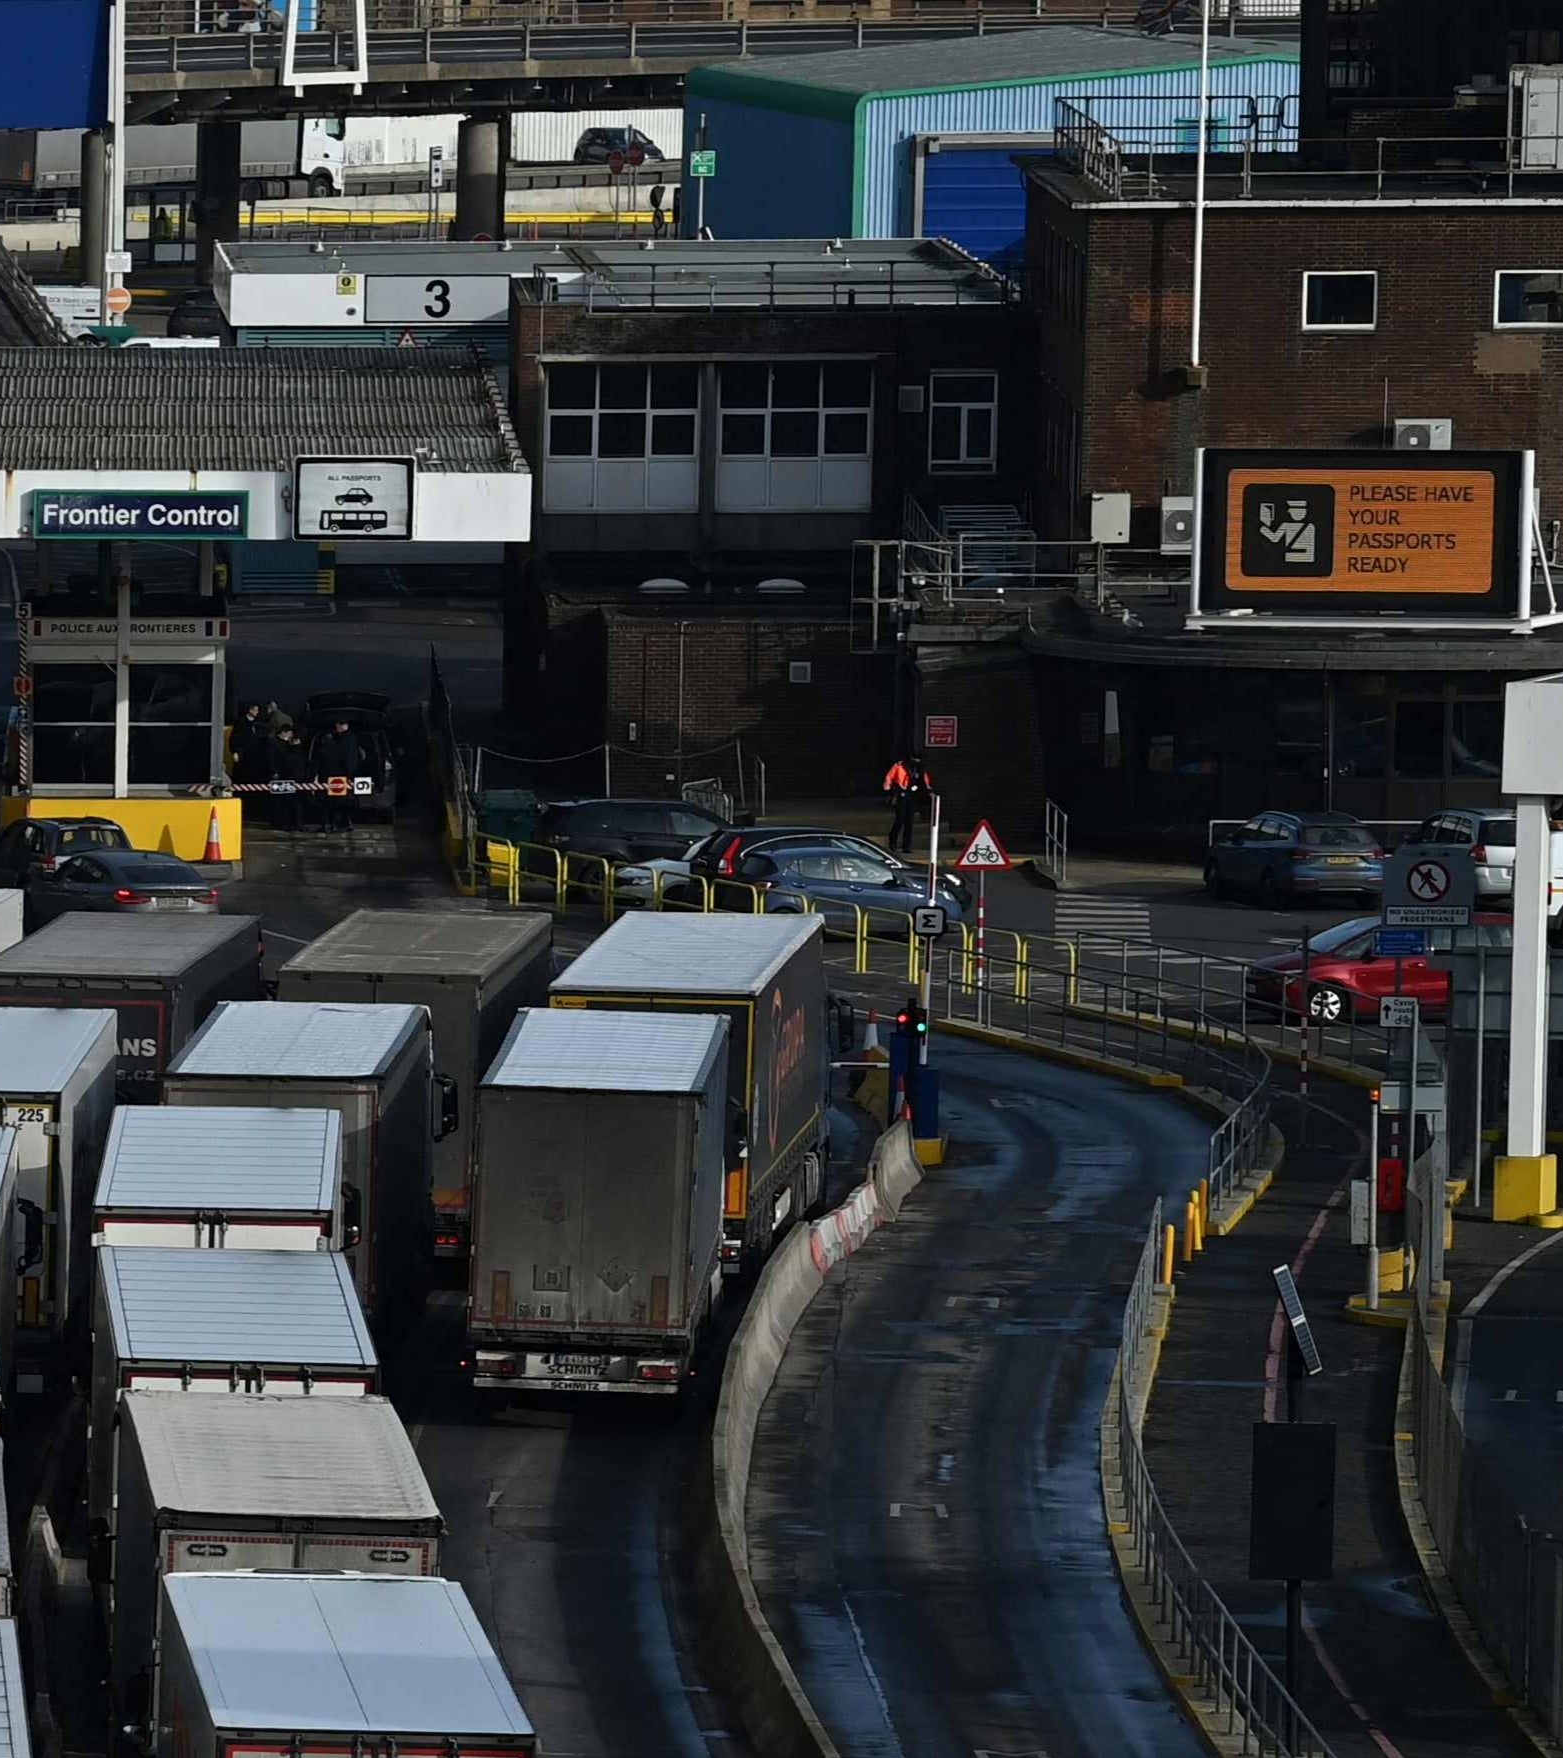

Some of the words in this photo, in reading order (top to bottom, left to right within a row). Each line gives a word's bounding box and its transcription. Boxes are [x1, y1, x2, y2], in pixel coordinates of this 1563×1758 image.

[425, 280, 450, 318] 3
[1350, 486, 1417, 501] PLEASE
[1425, 486, 1474, 501] HAVE
[43, 504, 140, 526] Frontier
[147, 504, 239, 526] Control
[1349, 509, 1400, 525] YOUR
[1349, 533, 1456, 549] PASSPORTS
[1348, 557, 1409, 573] READY
[19, 604, 29, 617] 5
[50, 624, 94, 634] POLICE
[130, 624, 197, 634] RONTIERES
[18, 1108, 44, 1122] 225
[547, 1365, 609, 1376] SCHMITZ
[551, 1382, 600, 1390] SCHMITZ
